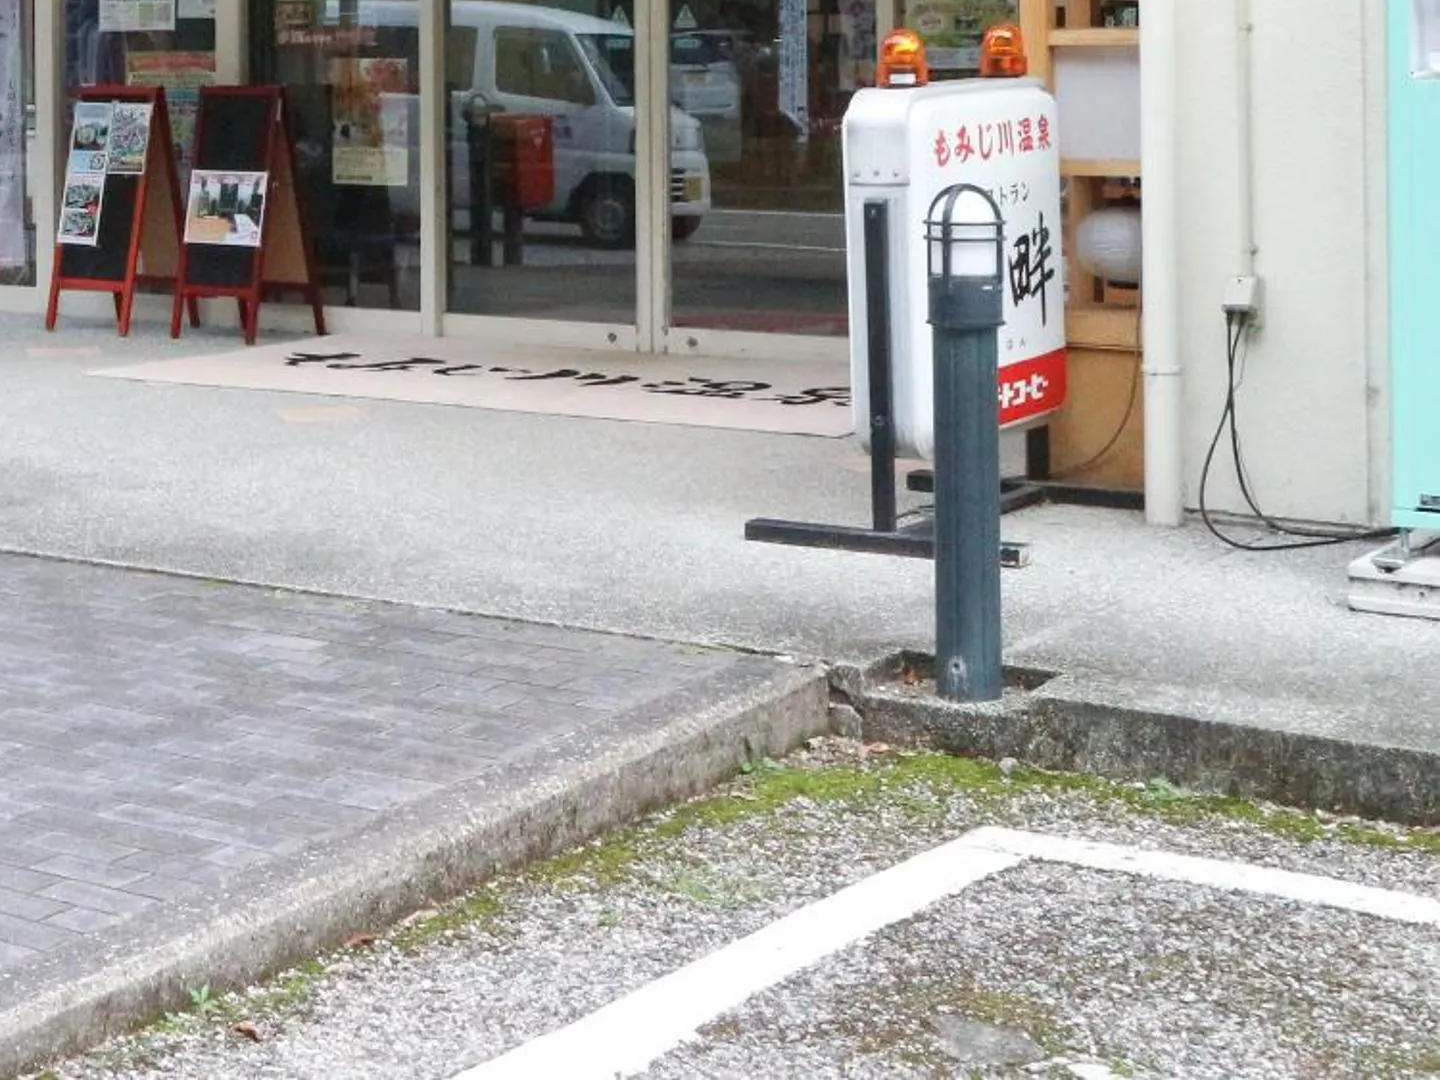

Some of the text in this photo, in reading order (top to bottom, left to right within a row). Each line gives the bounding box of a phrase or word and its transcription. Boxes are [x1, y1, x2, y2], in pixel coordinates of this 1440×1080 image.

[934, 114, 1051, 167] もみじ川温泉
